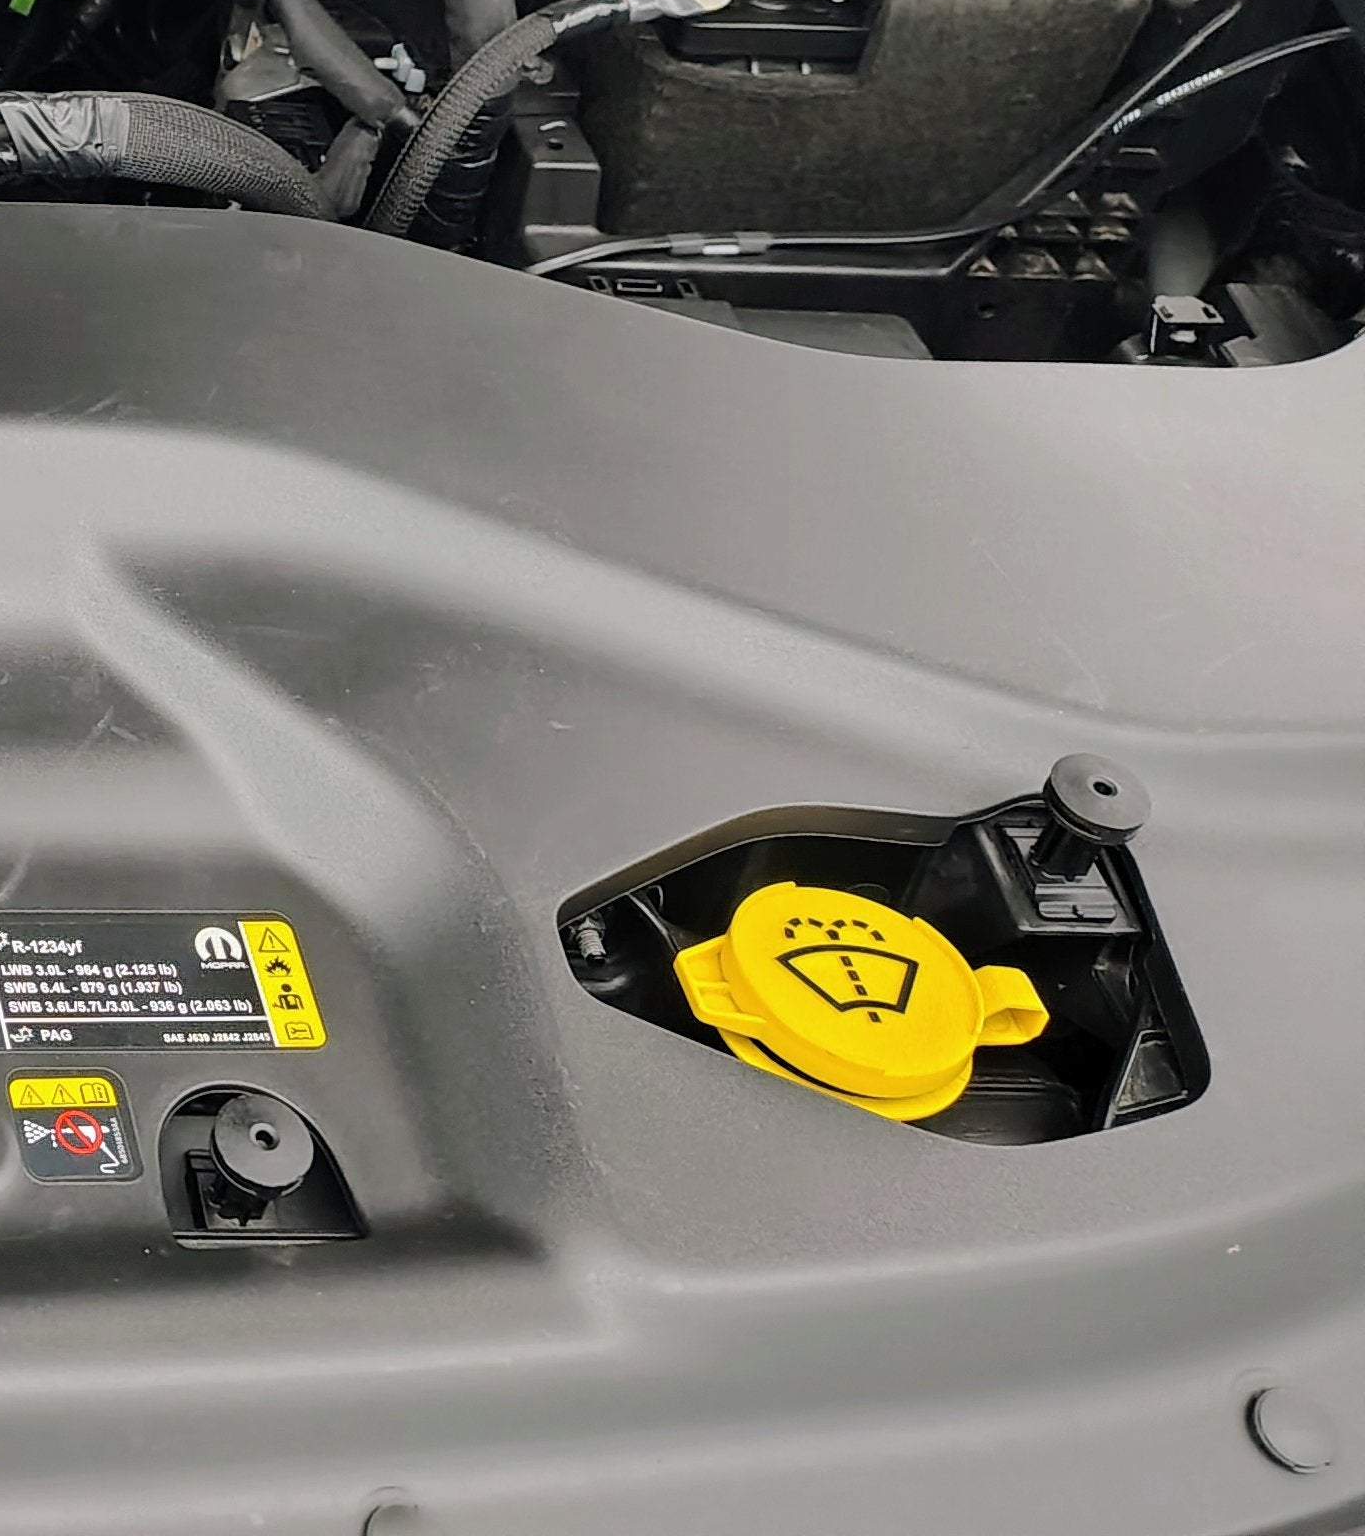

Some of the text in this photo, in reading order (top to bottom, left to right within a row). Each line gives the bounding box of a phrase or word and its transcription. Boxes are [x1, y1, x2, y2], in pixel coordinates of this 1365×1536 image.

[10, 939, 84, 956] R-1234yf
[0, 964, 33, 976] LWB
[35, 964, 66, 976] 3.0L
[115, 964, 157, 978] (2.125
[158, 963, 178, 978] lb)
[3, 981, 38, 994] SWB
[39, 981, 70, 994] 6.4L
[120, 981, 162, 995] (1.937
[163, 980, 183, 995] lb)
[7, 1000, 43, 1013] SWB
[232, 998, 253, 1014] lb)
[39, 1029, 73, 1042] PAG
[162, 1033, 186, 1043] SAE
